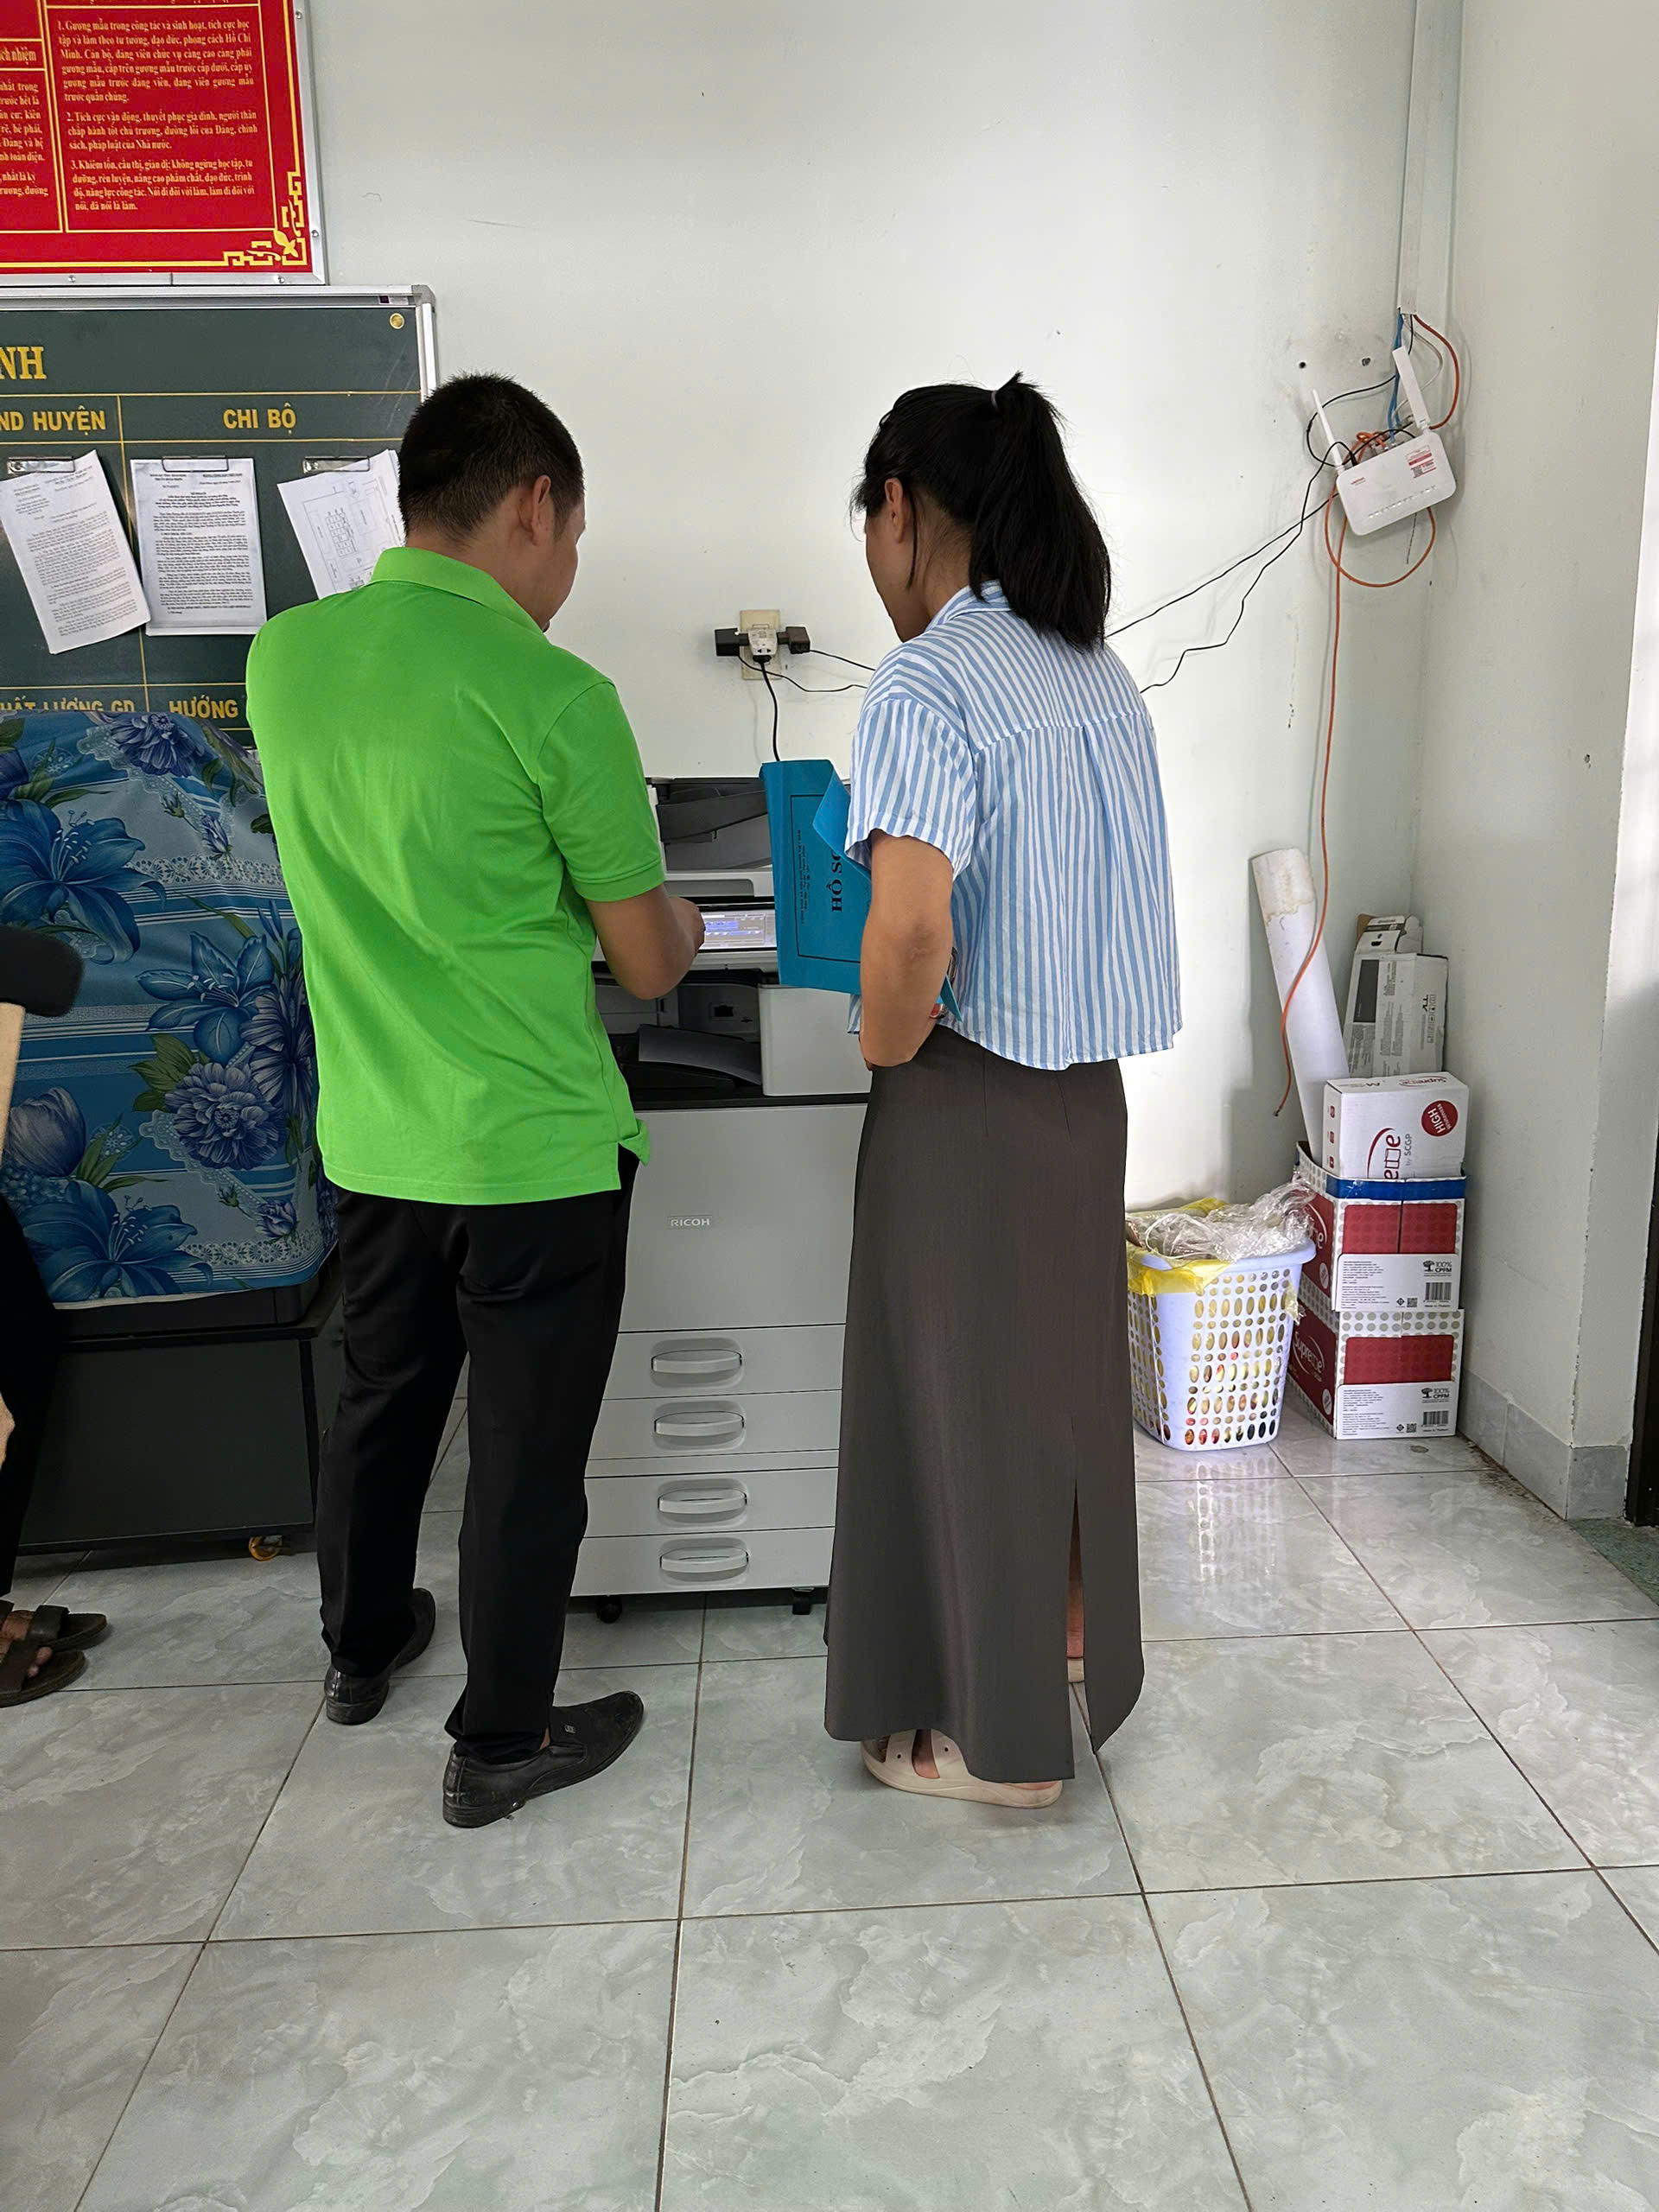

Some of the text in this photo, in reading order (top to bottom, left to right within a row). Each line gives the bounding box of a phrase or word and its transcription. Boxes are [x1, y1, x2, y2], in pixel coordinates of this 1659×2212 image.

[33, 405, 106, 435] HUYỆN
[223, 402, 296, 434] CHI BỘ
[169, 695, 239, 718] HƯỚNG
[1427, 1108, 1446, 1133] HIGH
[1404, 1134, 1412, 1156] SCGP
[671, 1218, 710, 1227] RICOH
